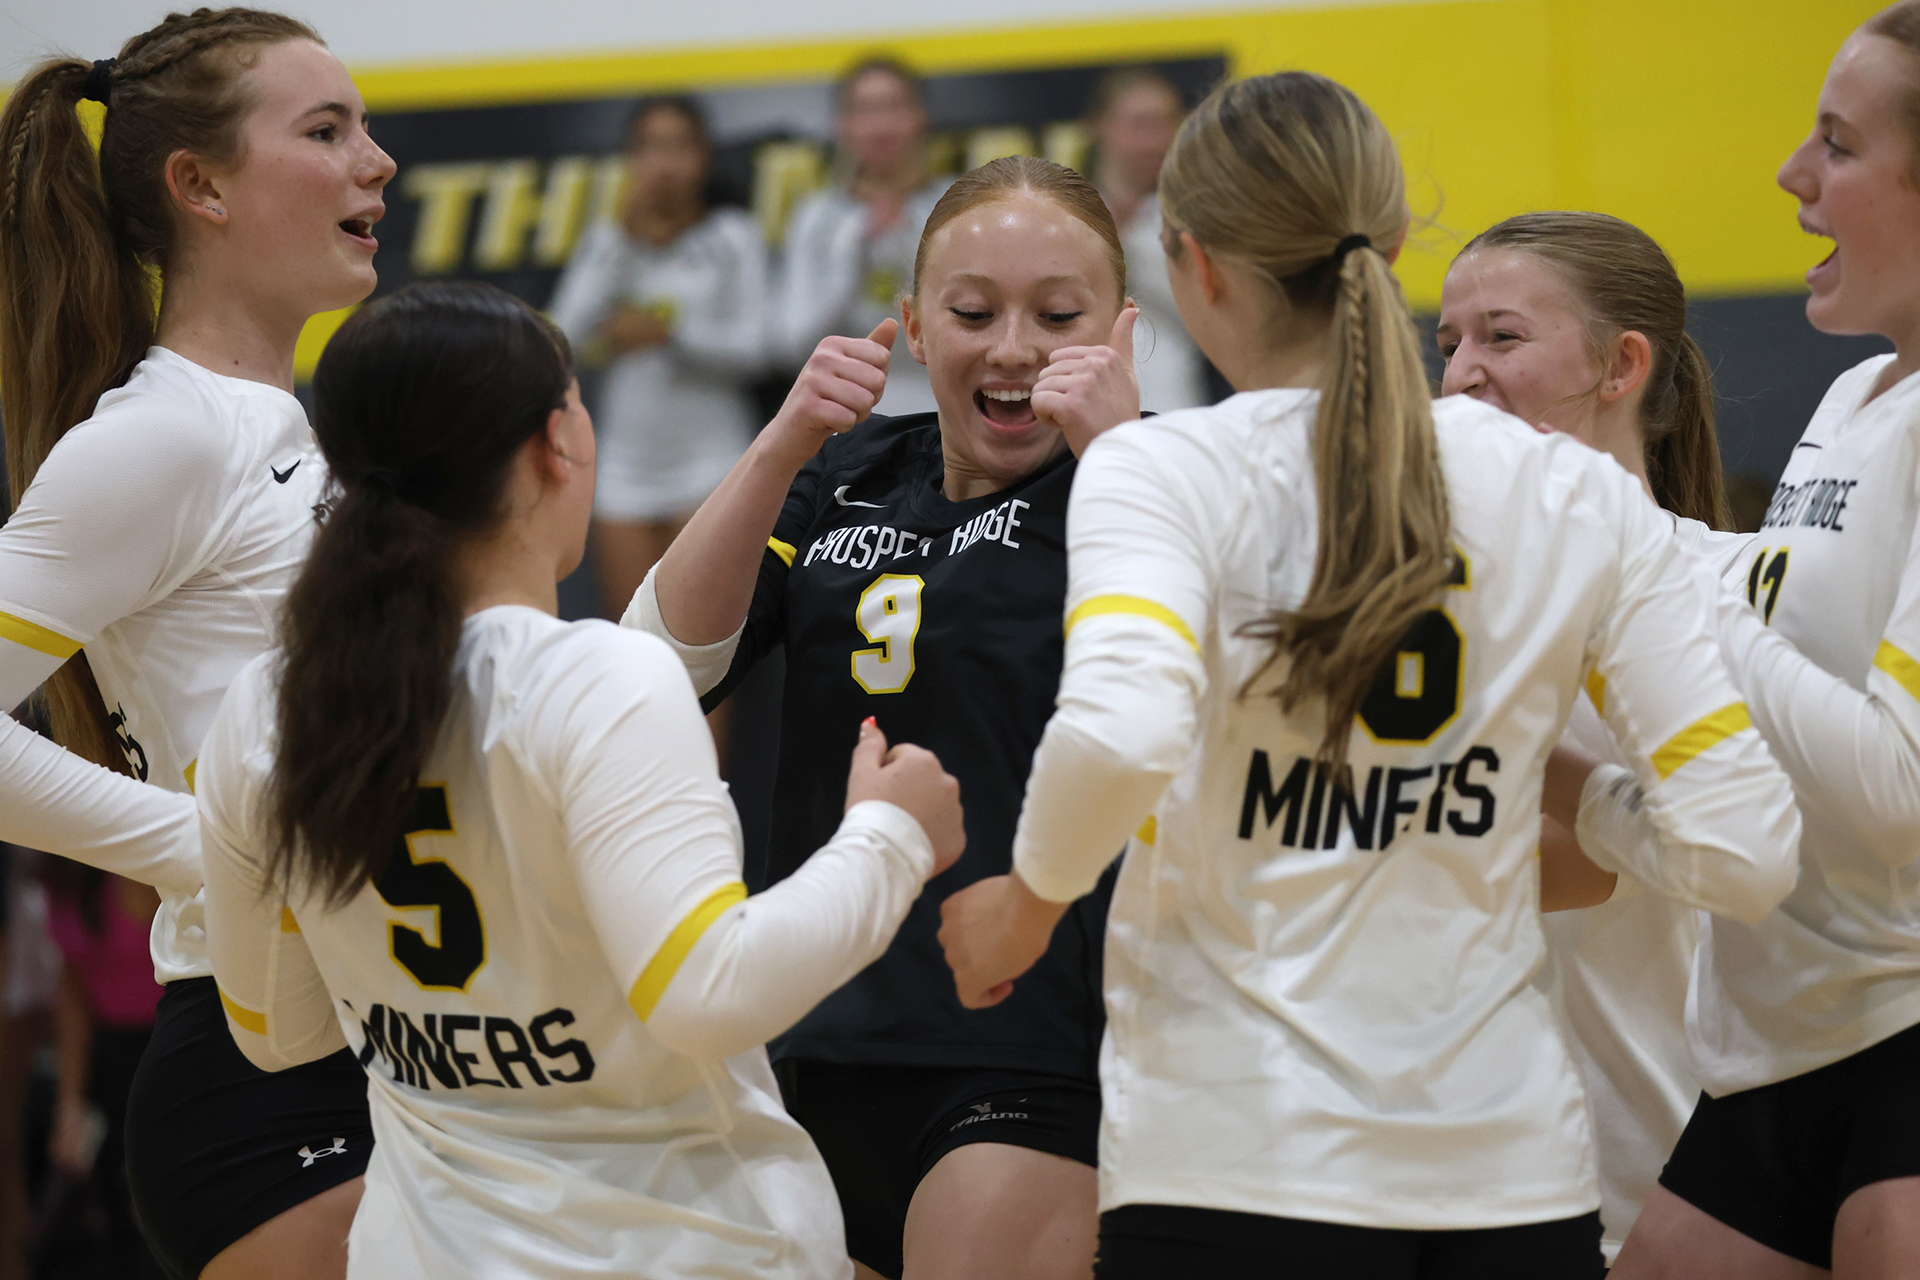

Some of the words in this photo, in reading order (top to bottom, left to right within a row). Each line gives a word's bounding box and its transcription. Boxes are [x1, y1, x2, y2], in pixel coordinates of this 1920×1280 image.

[851, 572, 926, 695] 9
[368, 780, 489, 994] 5
[341, 998, 596, 1091] MINERS
